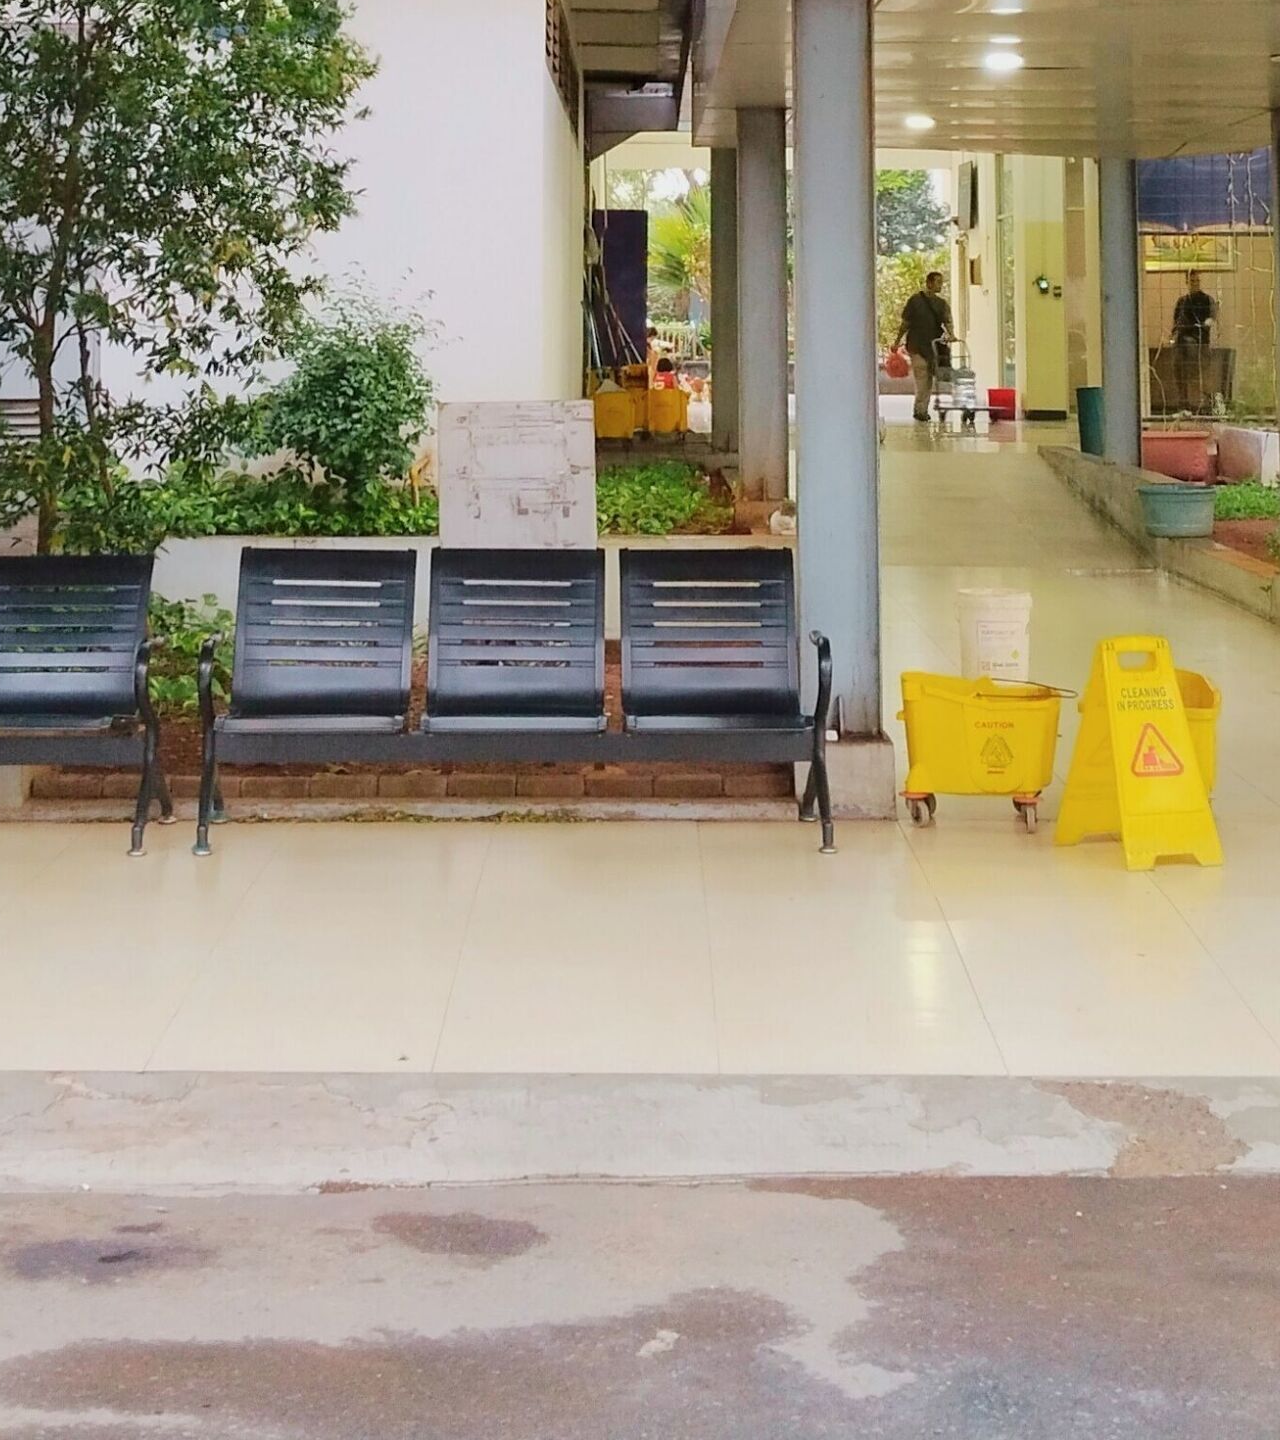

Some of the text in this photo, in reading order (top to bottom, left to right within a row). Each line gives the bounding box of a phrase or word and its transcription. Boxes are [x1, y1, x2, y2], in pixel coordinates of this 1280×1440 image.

[1120, 686, 1167, 698] CLEANING
[1116, 698, 1175, 712] IN PROGRESS
[974, 721, 1014, 729] CAUTION
